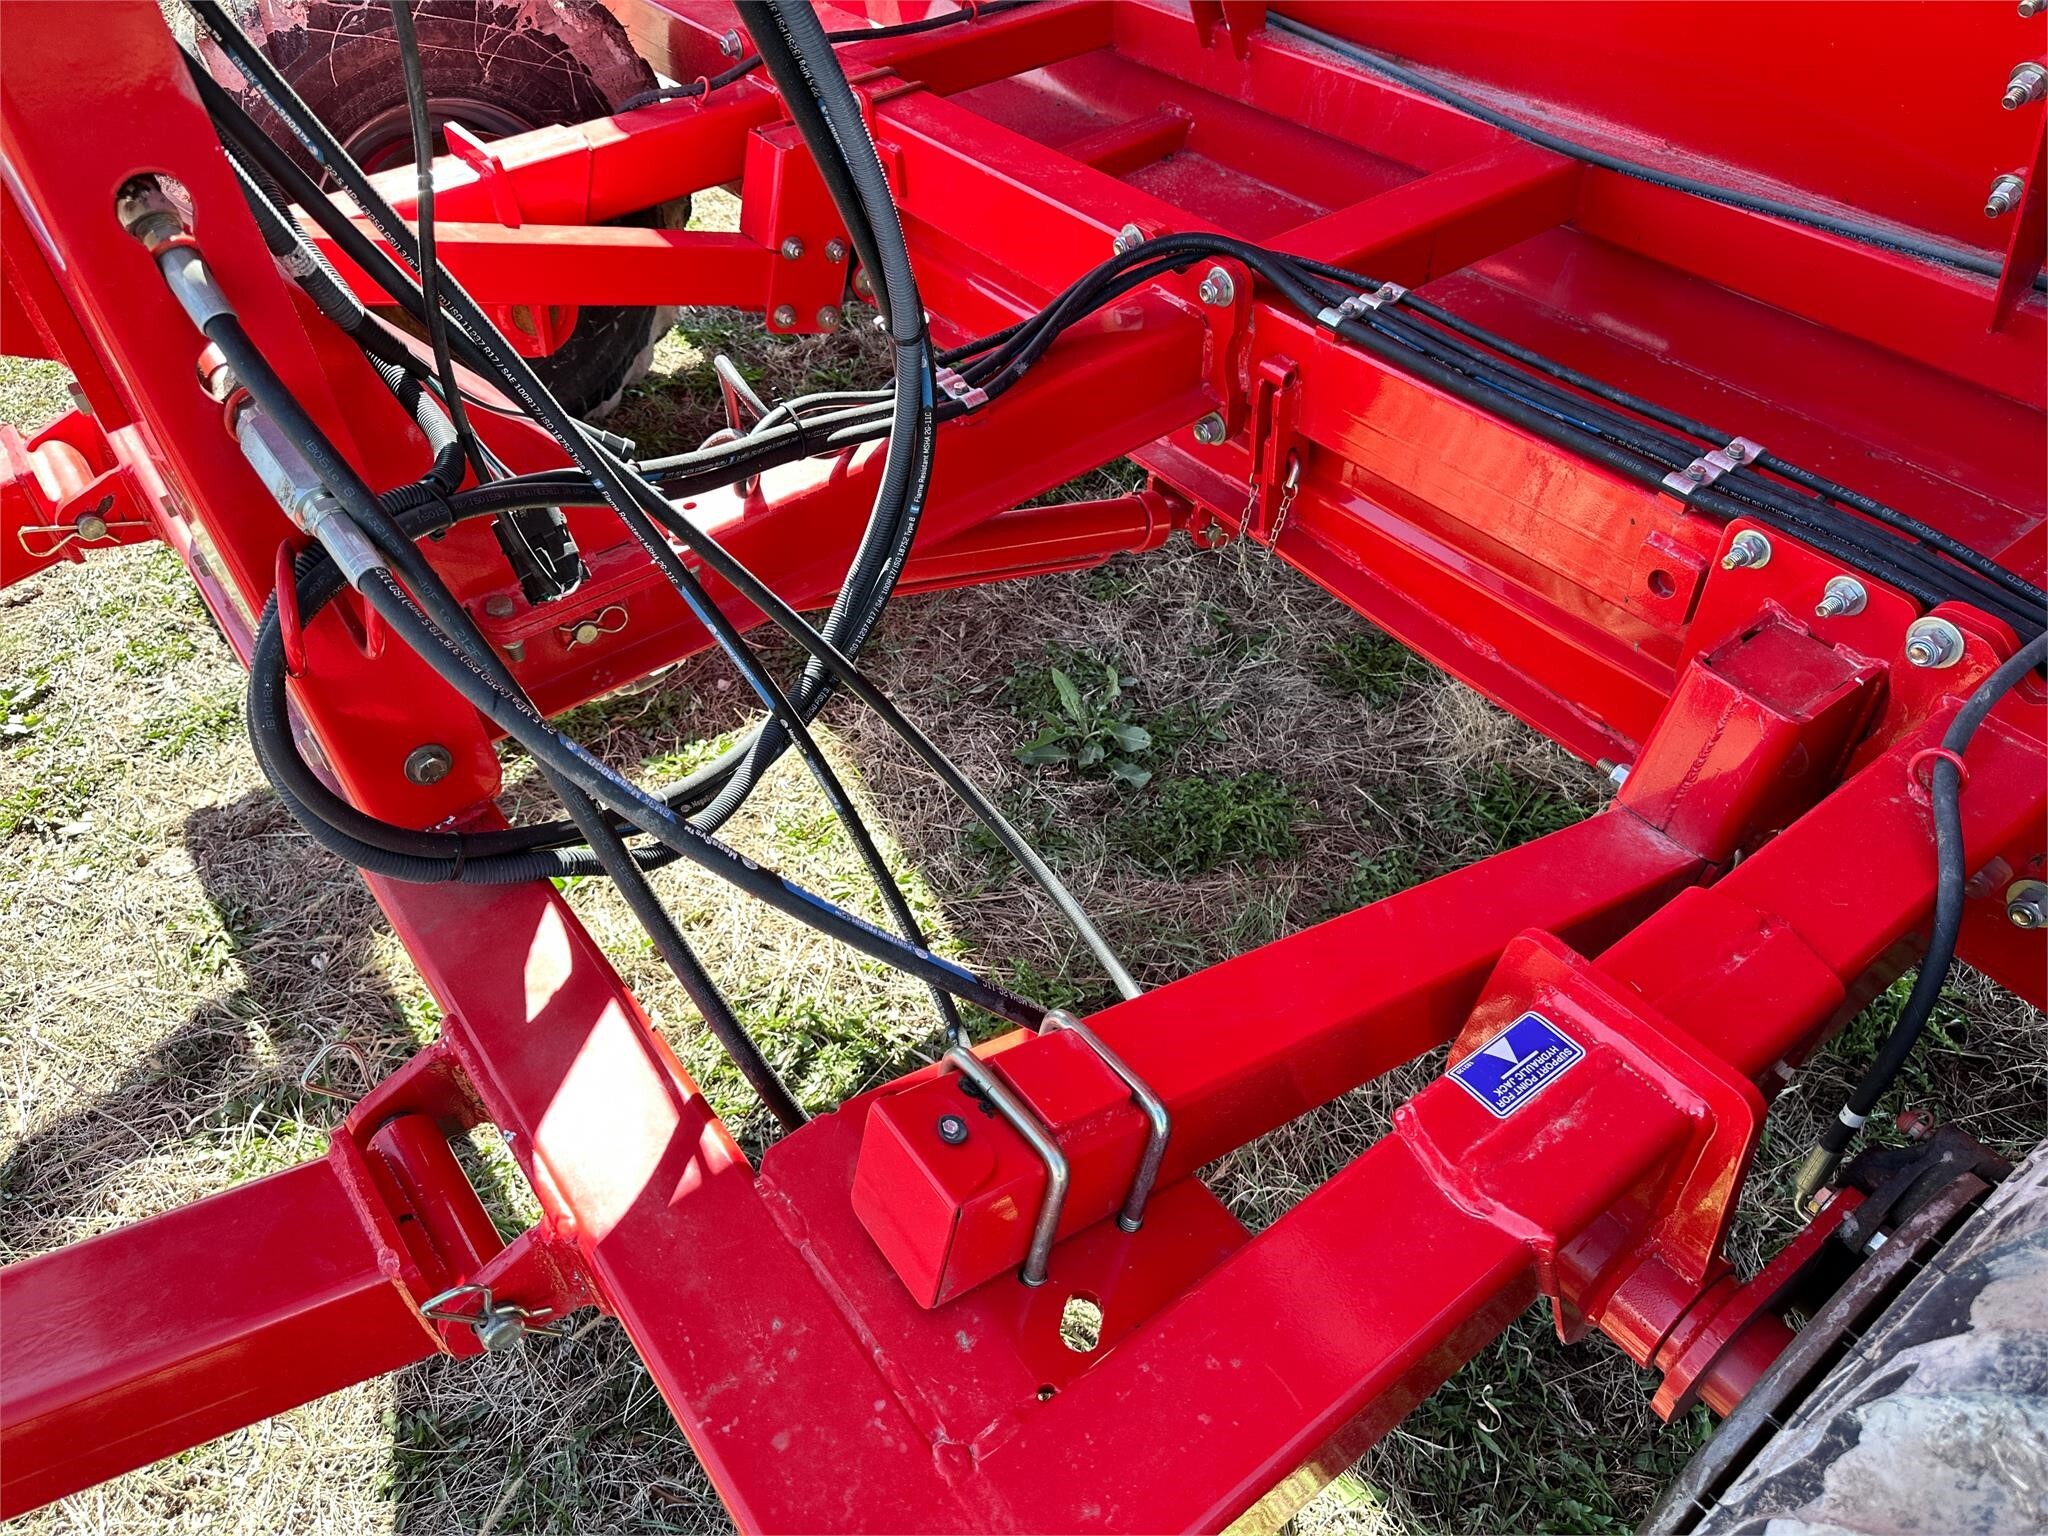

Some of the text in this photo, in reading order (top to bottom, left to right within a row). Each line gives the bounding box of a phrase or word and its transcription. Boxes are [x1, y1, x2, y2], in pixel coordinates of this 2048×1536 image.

[231, 55, 258, 84] 6M3K
[324, 163, 344, 185] 22.5
[342, 183, 362, 205] MPa
[448, 305, 463, 321] ISO
[461, 320, 485, 346] 11237
[482, 345, 499, 364] R17
[500, 367, 516, 384] SAE
[539, 414, 554, 430] ISO
[550, 428, 574, 454] 18752
[569, 452, 587, 471] Type
[600, 489, 621, 513] Flame
[617, 510, 645, 543] Resistant
[642, 540, 660, 561] MSHA
[656, 558, 679, 586] 2G-11C
[924, 411, 932, 434] 2G-11C
[922, 436, 931, 453] MSHA
[917, 454, 930, 482] Resistant
[913, 483, 923, 502] Flame
[903, 521, 915, 536] Type
[896, 536, 910, 557] 18752
[892, 556, 902, 568] ISO
[1979, 557, 1997, 571] IN
[387, 581, 406, 601] ISO
[874, 593, 886, 608] SAE
[865, 610, 877, 624] R17
[855, 623, 871, 644] 11237
[509, 695, 534, 717] MPa
[640, 793, 671, 818] 6M3K
[682, 822, 739, 860] MegaSys™
[1492, 1043, 1559, 1098] HYDRAULIC JACK
[1495, 1046, 1572, 1109] SUPPORT POINT FOR
